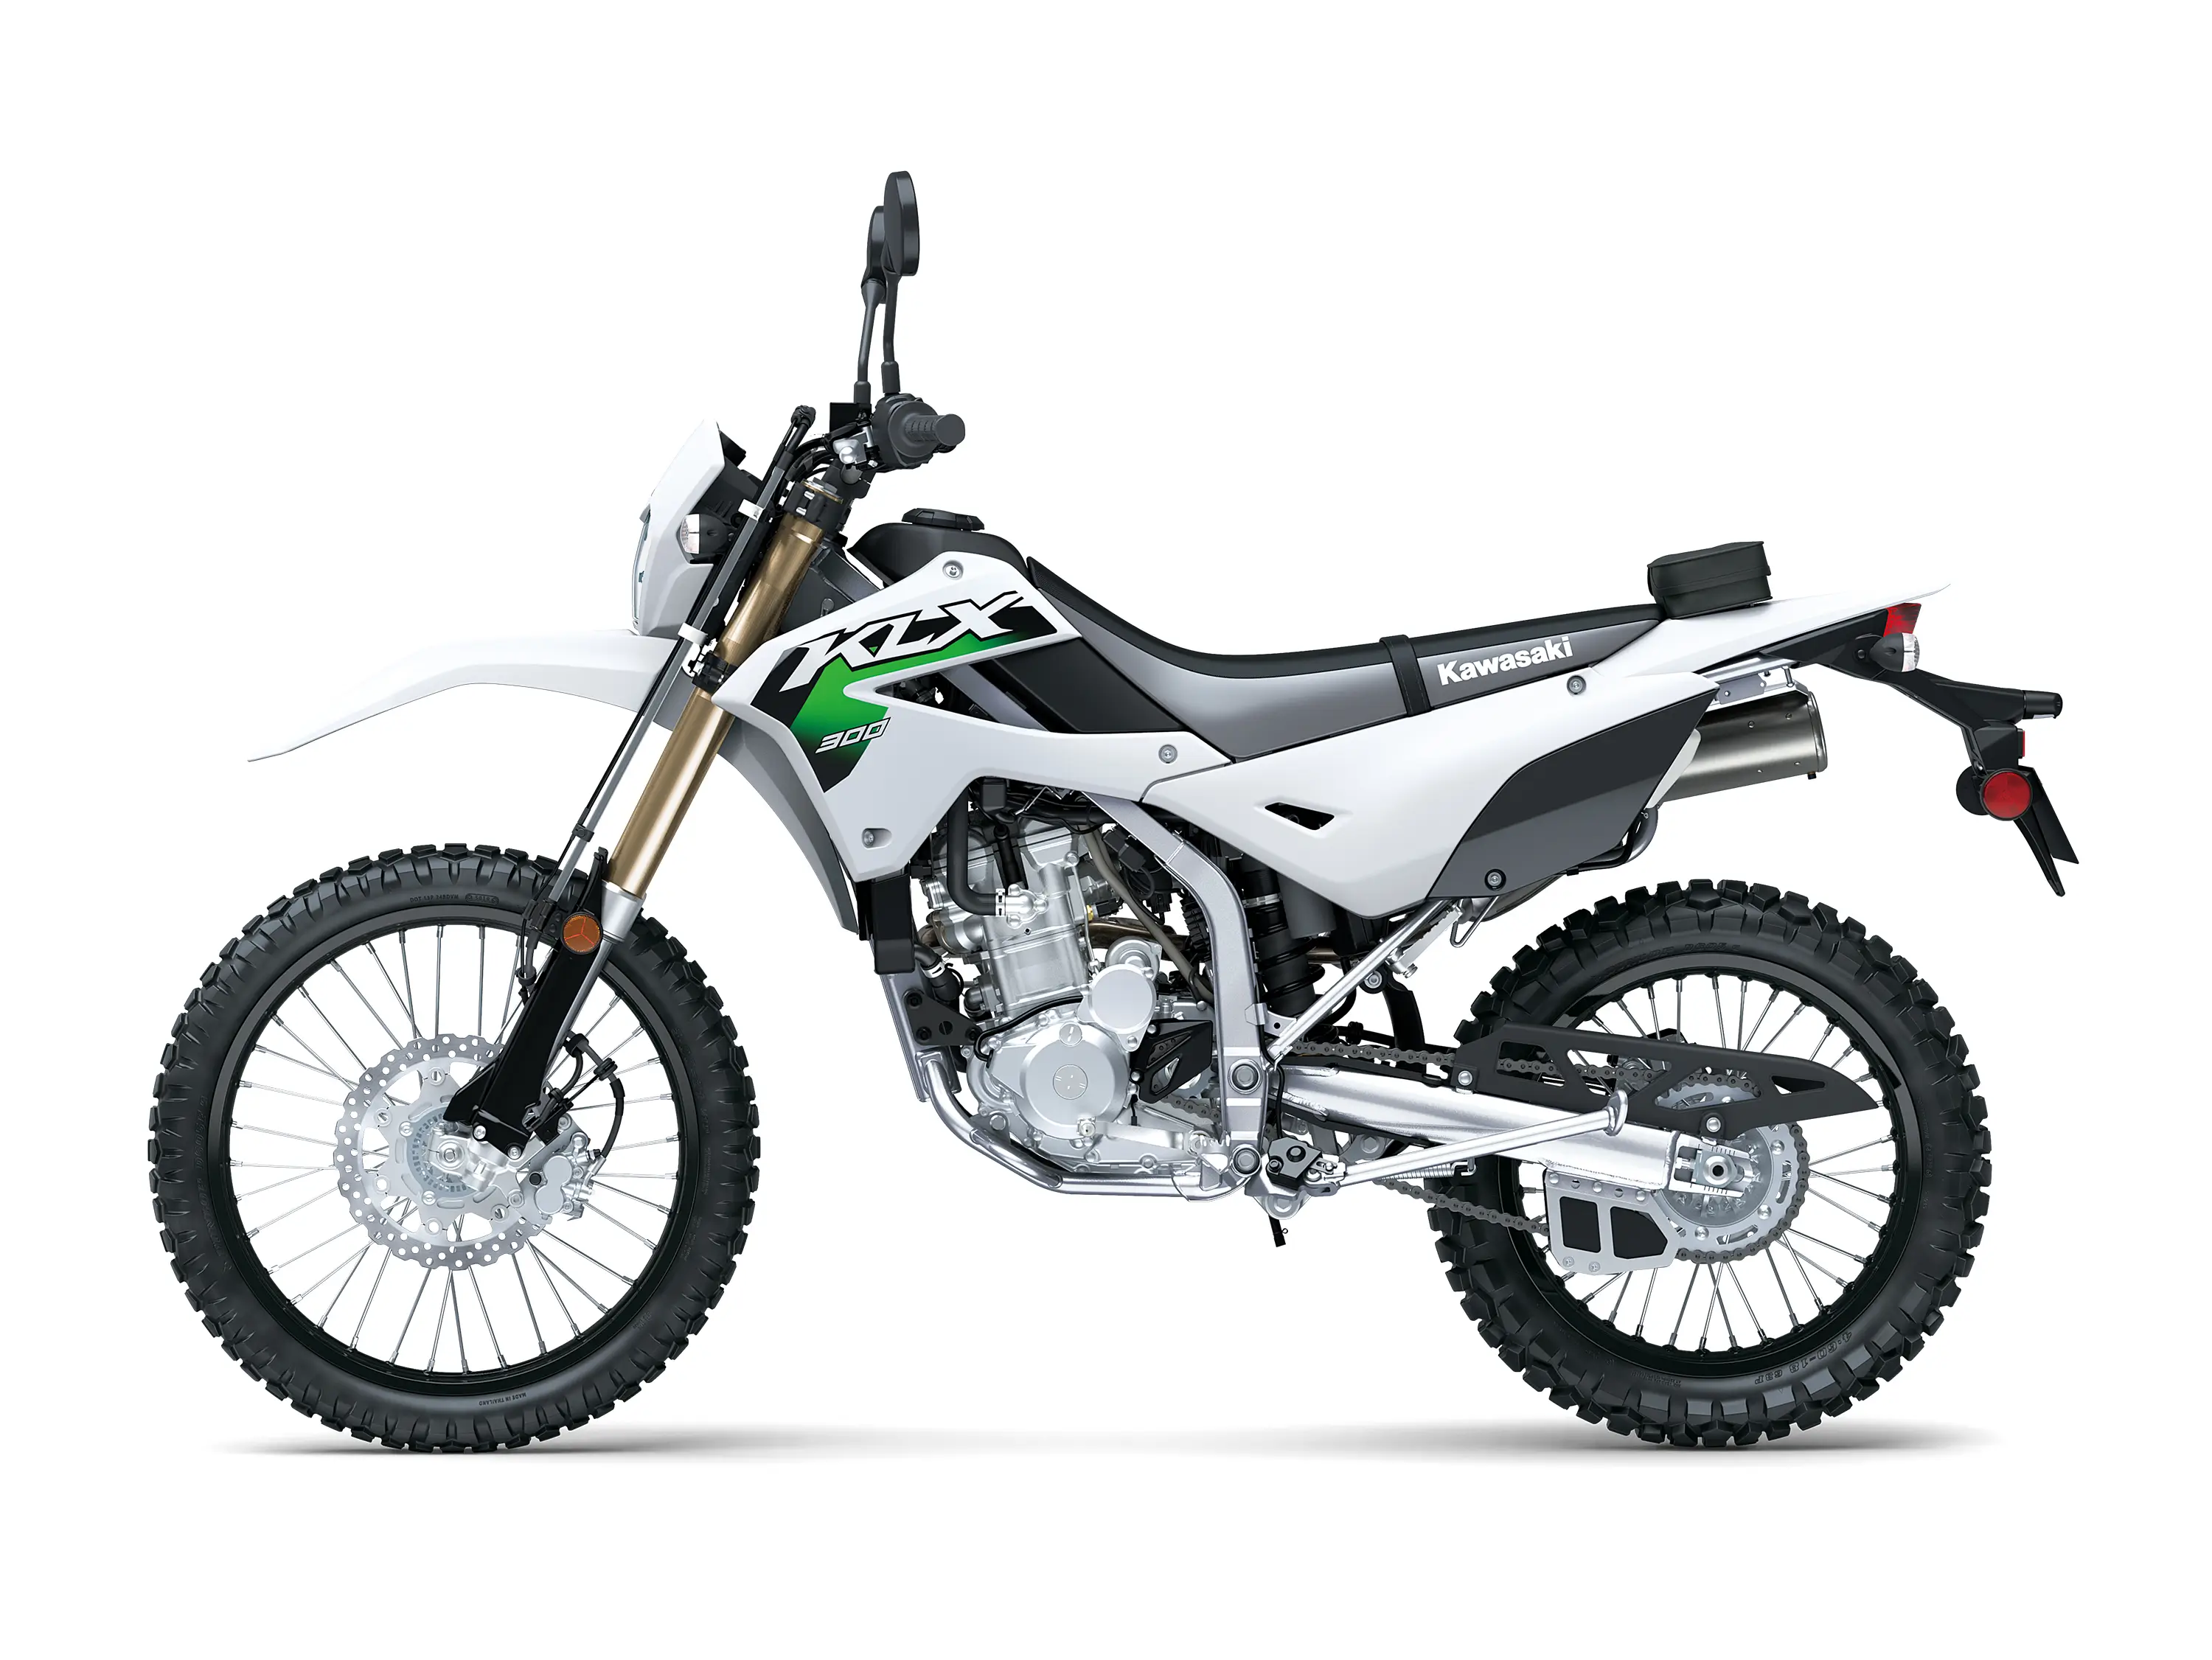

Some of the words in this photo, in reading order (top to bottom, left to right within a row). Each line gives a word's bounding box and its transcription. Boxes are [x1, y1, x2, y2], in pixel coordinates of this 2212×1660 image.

[779, 590, 1024, 693] KLX
[1436, 635, 1573, 686] Kawasaki
[815, 716, 891, 754] 300
[1754, 1369, 1783, 1385] 63P
